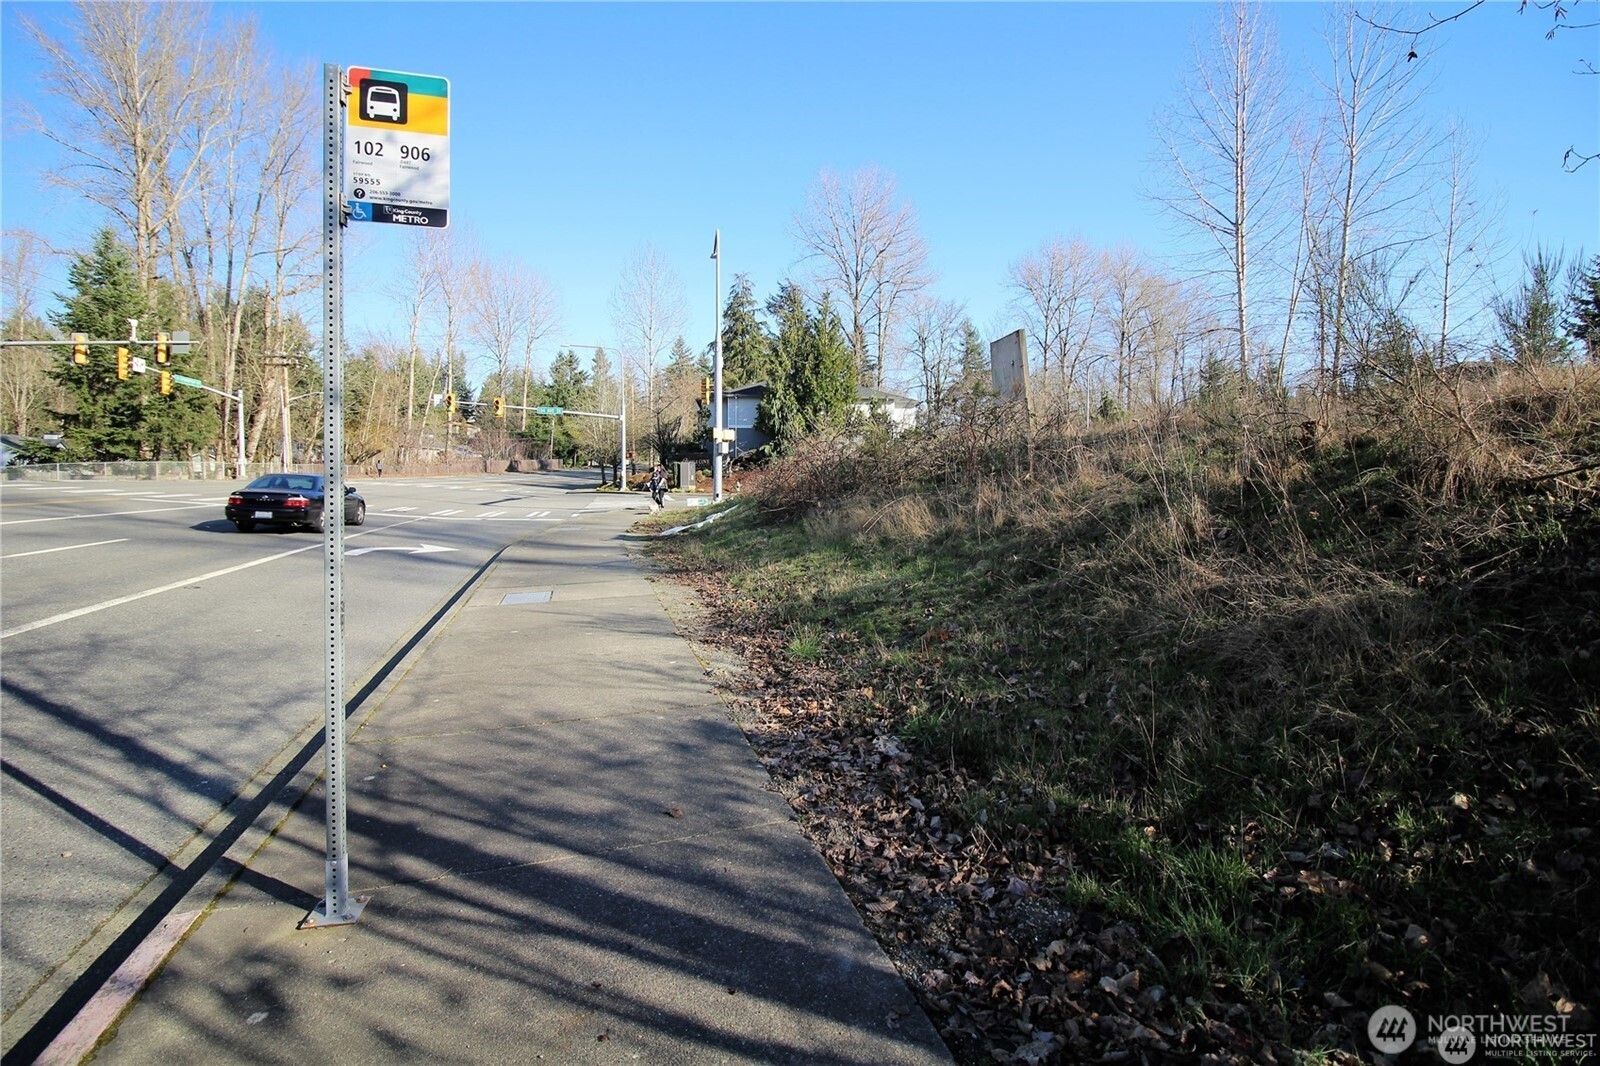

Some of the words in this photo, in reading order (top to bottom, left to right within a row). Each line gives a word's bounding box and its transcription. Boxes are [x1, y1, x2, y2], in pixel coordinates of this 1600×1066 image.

[354, 140, 383, 156] 102
[400, 145, 430, 161] 906
[352, 176, 381, 186] 59555
[369, 196, 433, 205] www.kingcounty.gov/metro
[392, 214, 429, 225] METRO
